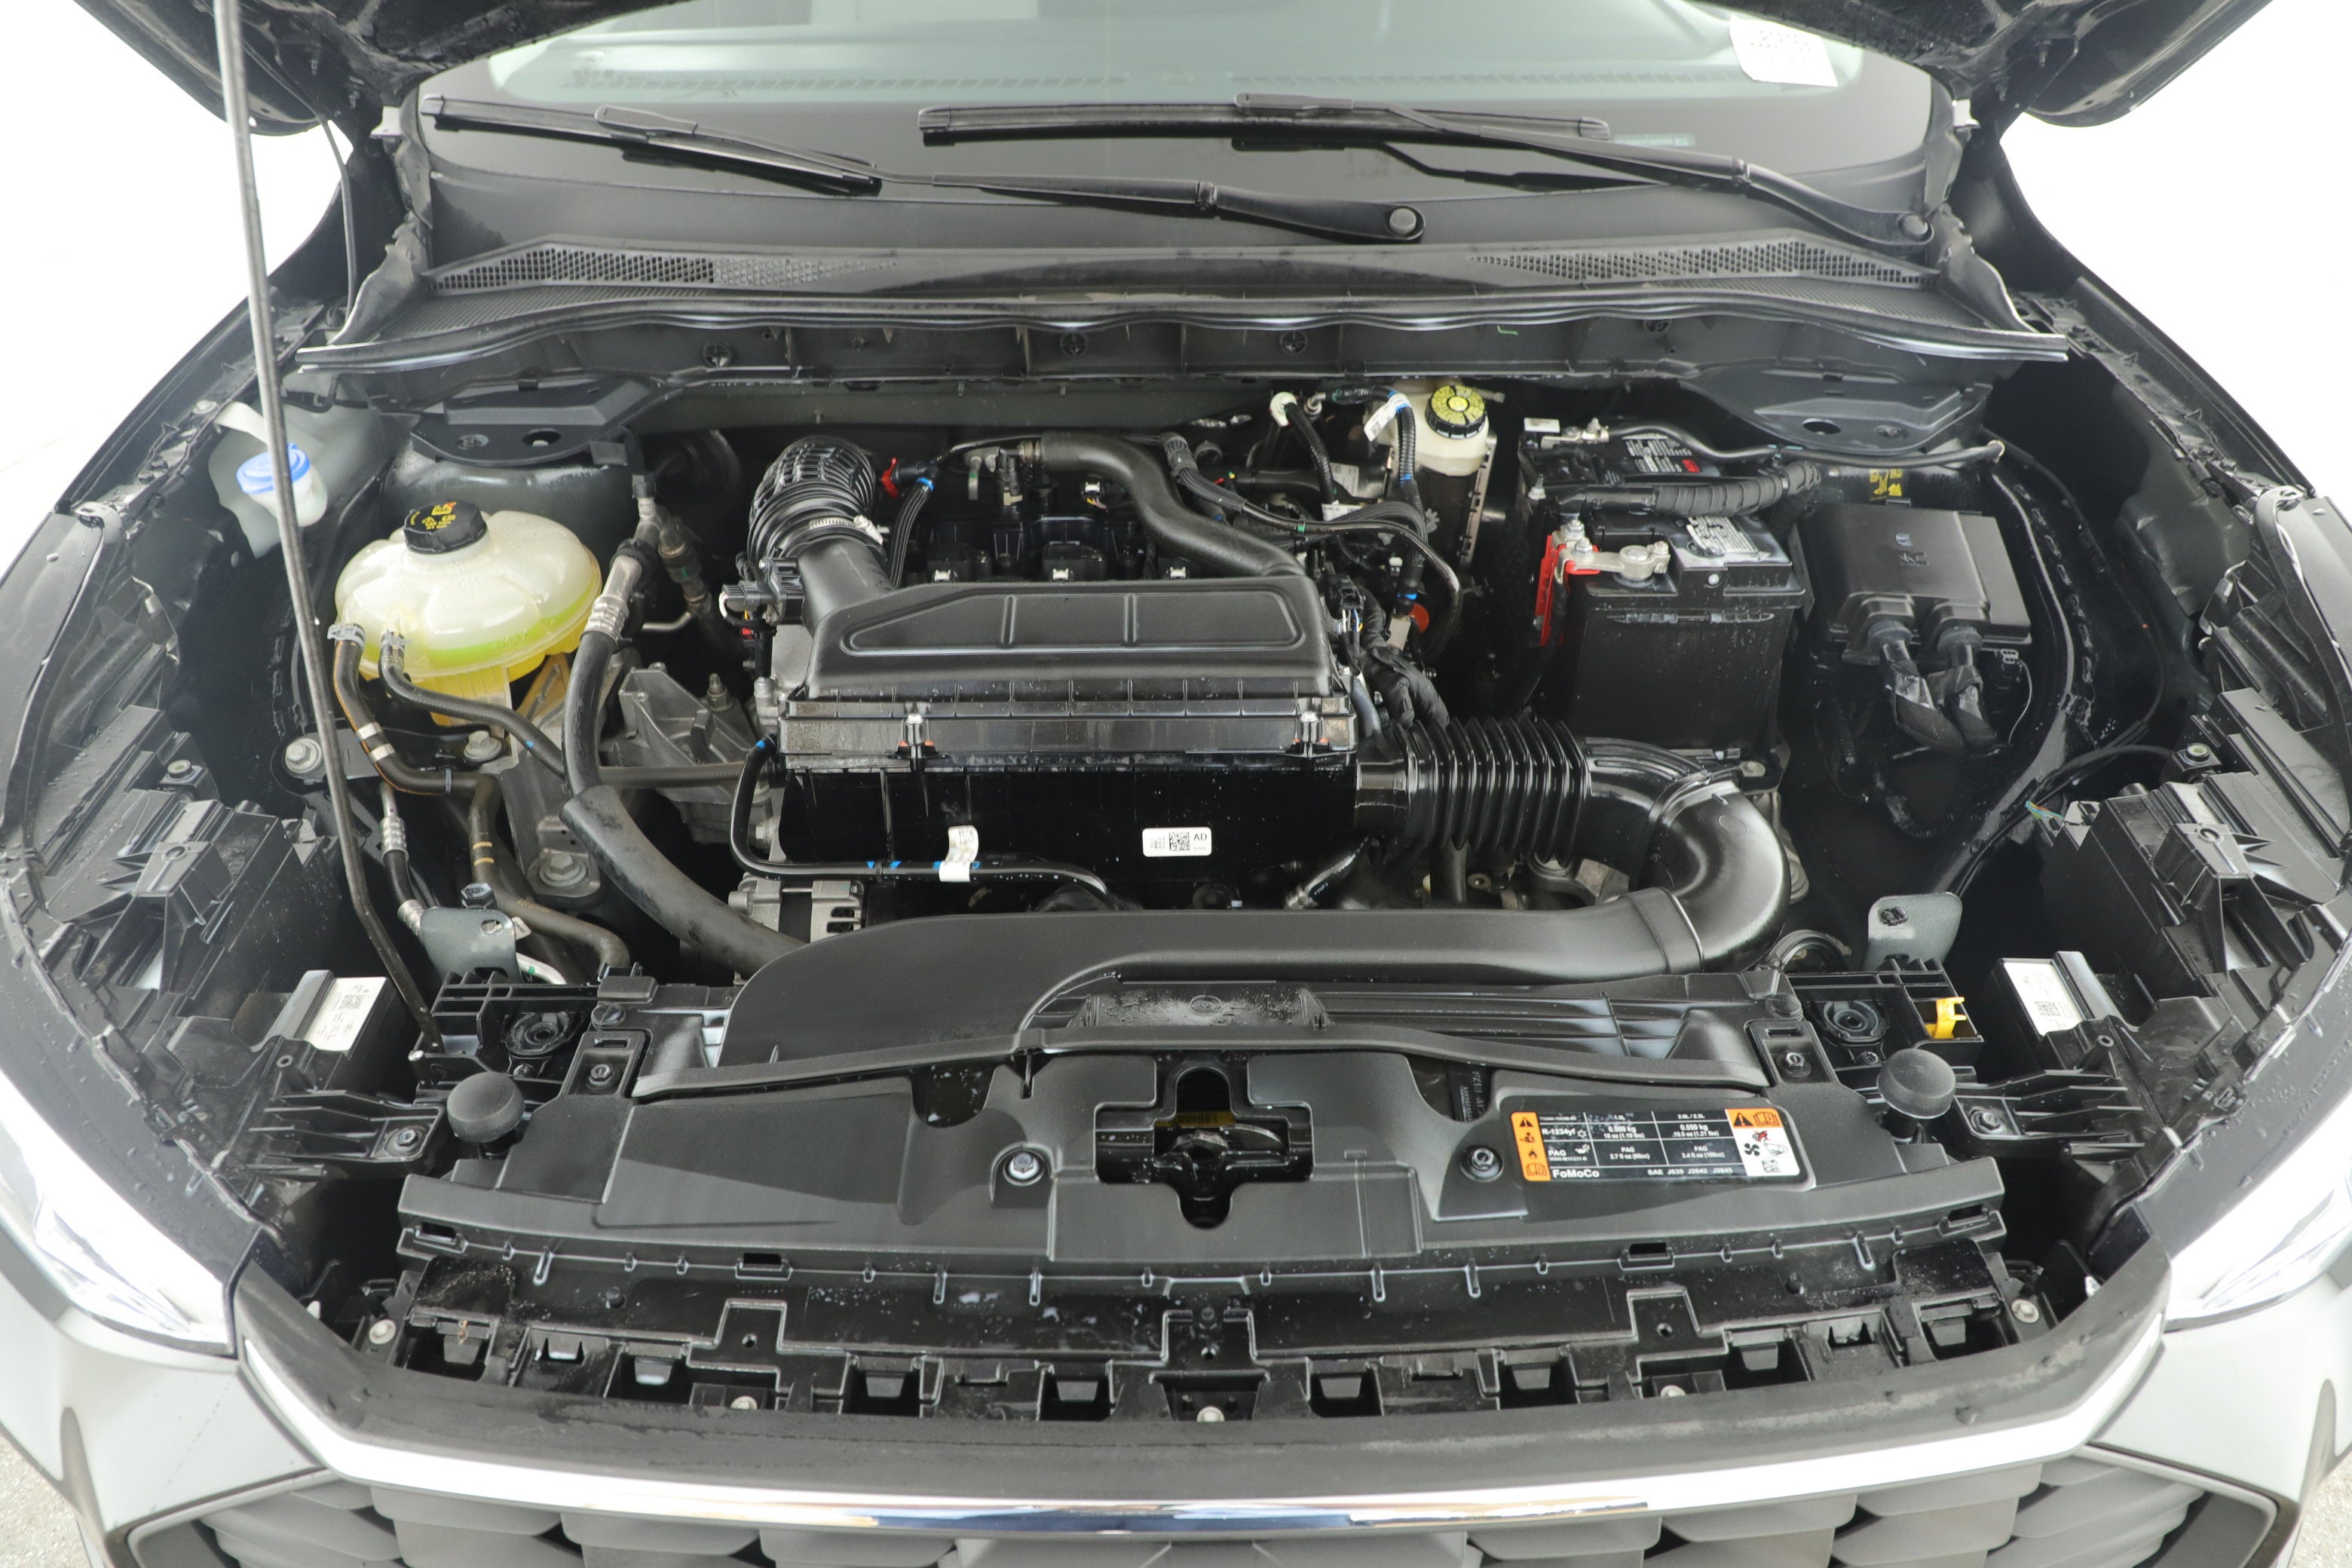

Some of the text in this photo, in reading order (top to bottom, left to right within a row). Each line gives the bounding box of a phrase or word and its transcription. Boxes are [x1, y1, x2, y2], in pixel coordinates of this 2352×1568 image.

[1193, 833, 1208, 841] AD
[1542, 1128, 1576, 1136] R-1234yf
[1627, 1125, 1637, 1134] kg
[1698, 1123, 1708, 1132] kg
[1552, 1169, 1600, 1178] FoMoCo
